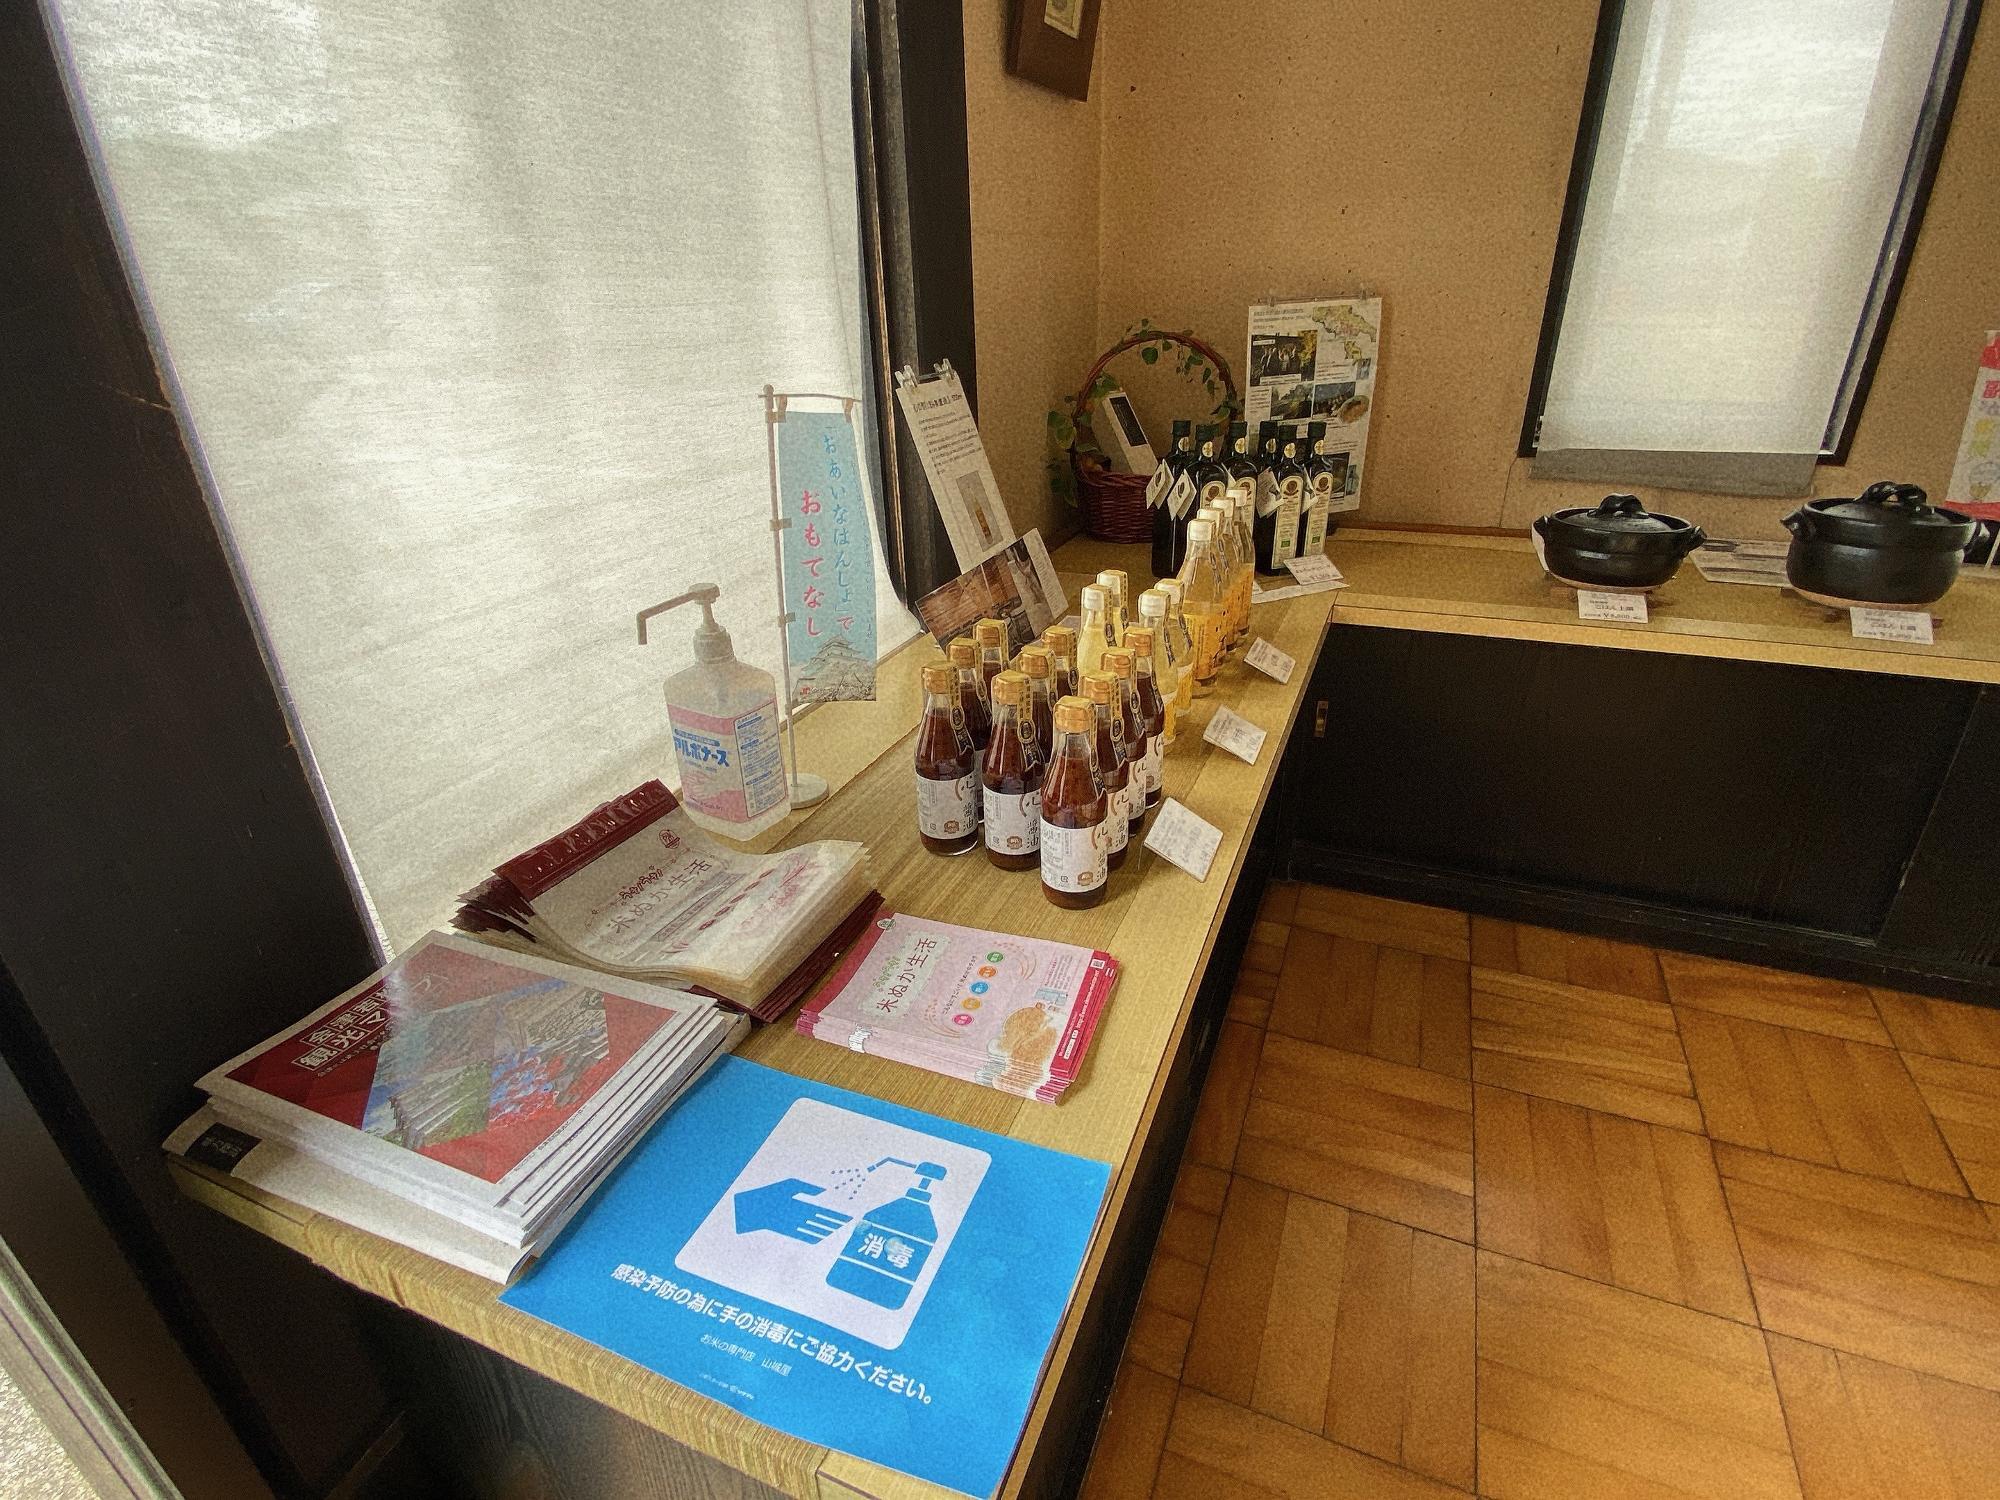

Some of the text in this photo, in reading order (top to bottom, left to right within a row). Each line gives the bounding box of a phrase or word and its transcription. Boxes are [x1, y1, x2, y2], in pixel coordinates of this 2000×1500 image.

[800, 489, 825, 637] おもてなし
[608, 858, 713, 934] 米ぬか生活
[876, 938, 938, 1013] 米ぬか生活
[857, 1232, 915, 1269] 消毒
[610, 1262, 932, 1405] 感染予防の為に手の消毒にご協力ください。
[700, 1333, 756, 1362] お米の専門店
